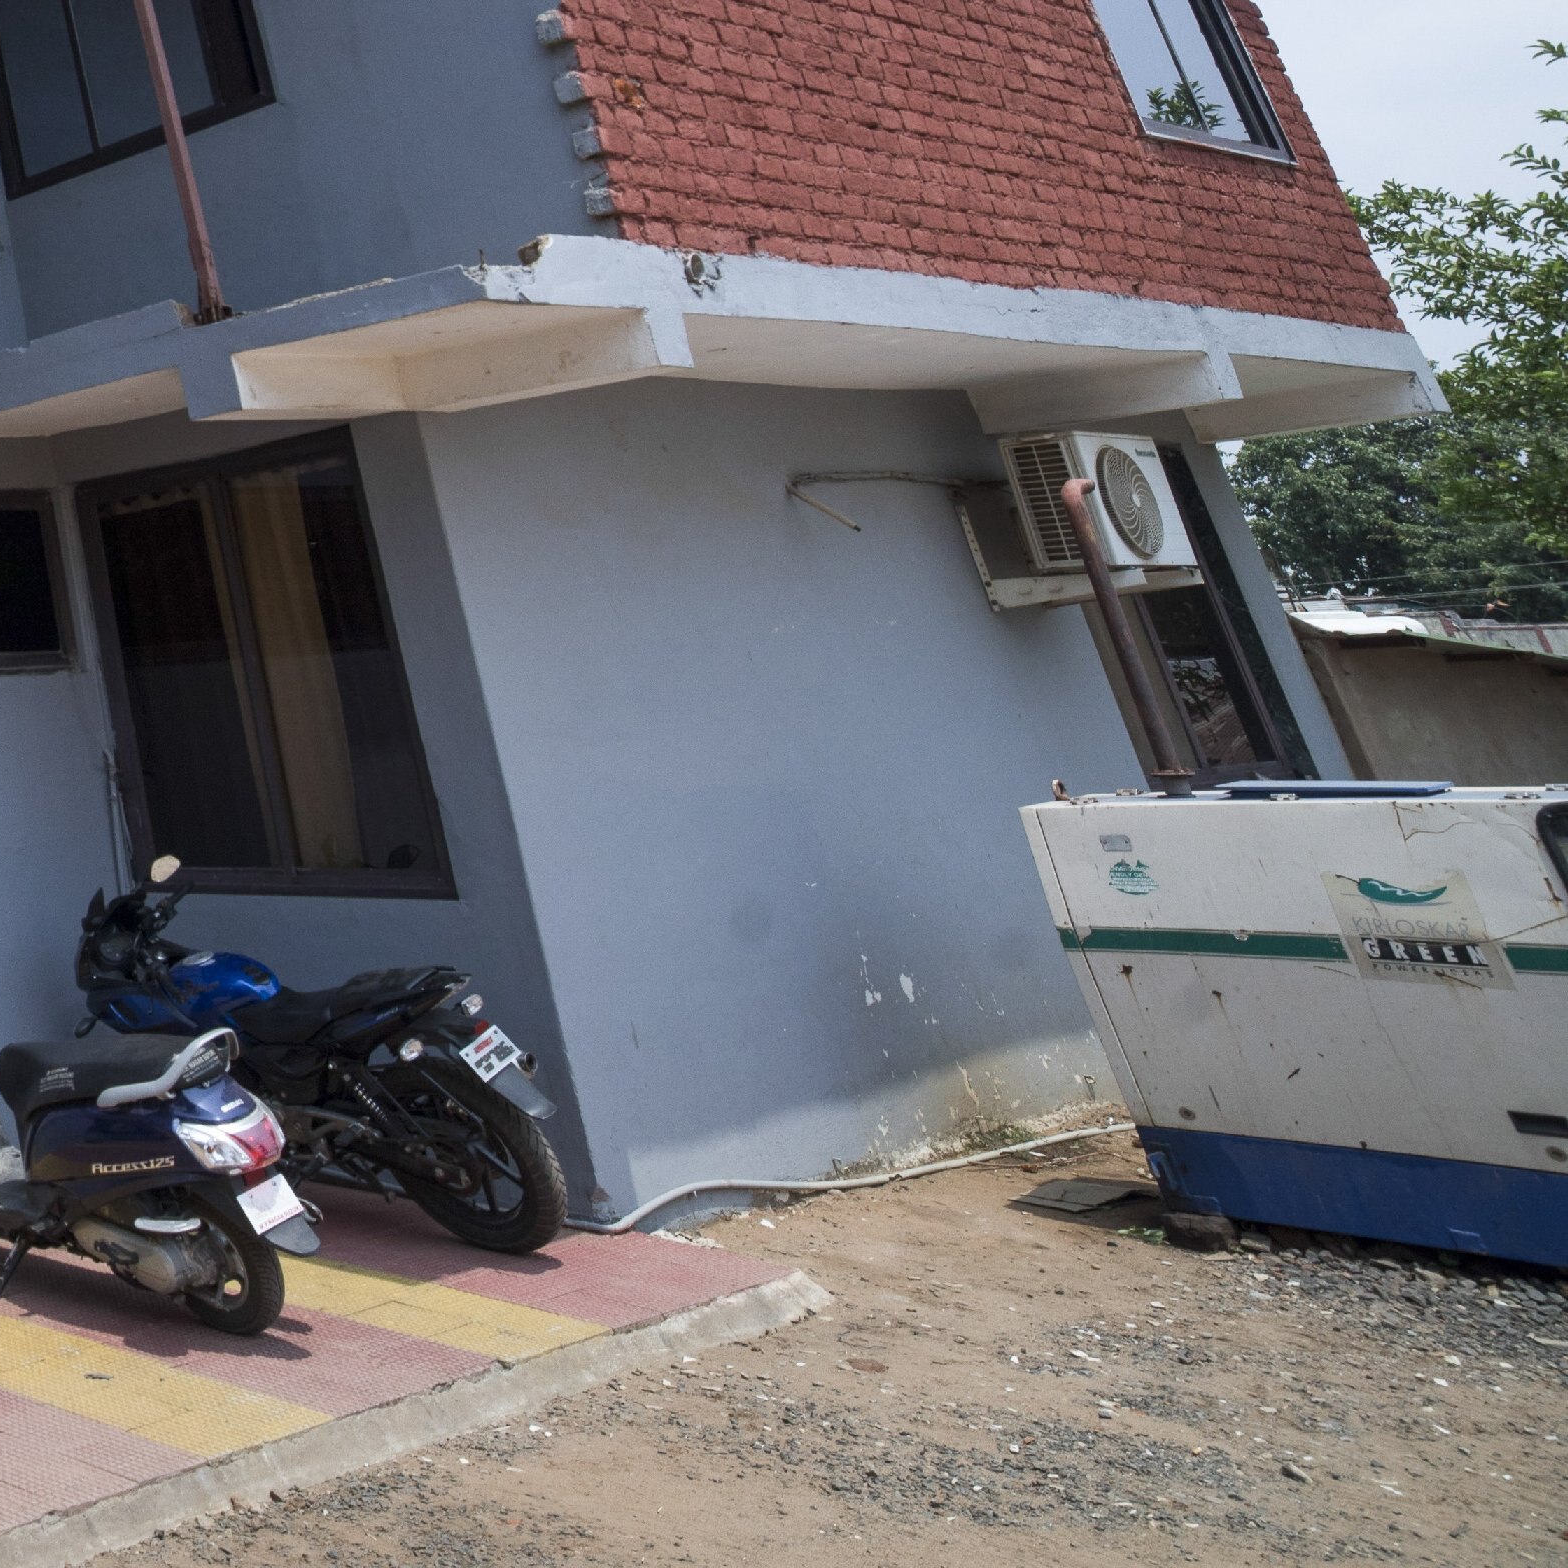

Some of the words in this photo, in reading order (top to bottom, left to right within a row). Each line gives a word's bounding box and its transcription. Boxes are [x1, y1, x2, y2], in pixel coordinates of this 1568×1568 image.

[1352, 916, 1471, 940] KIRLOSKAR
[1363, 939, 1489, 965] GREEN
[1372, 963, 1429, 974] POWER
